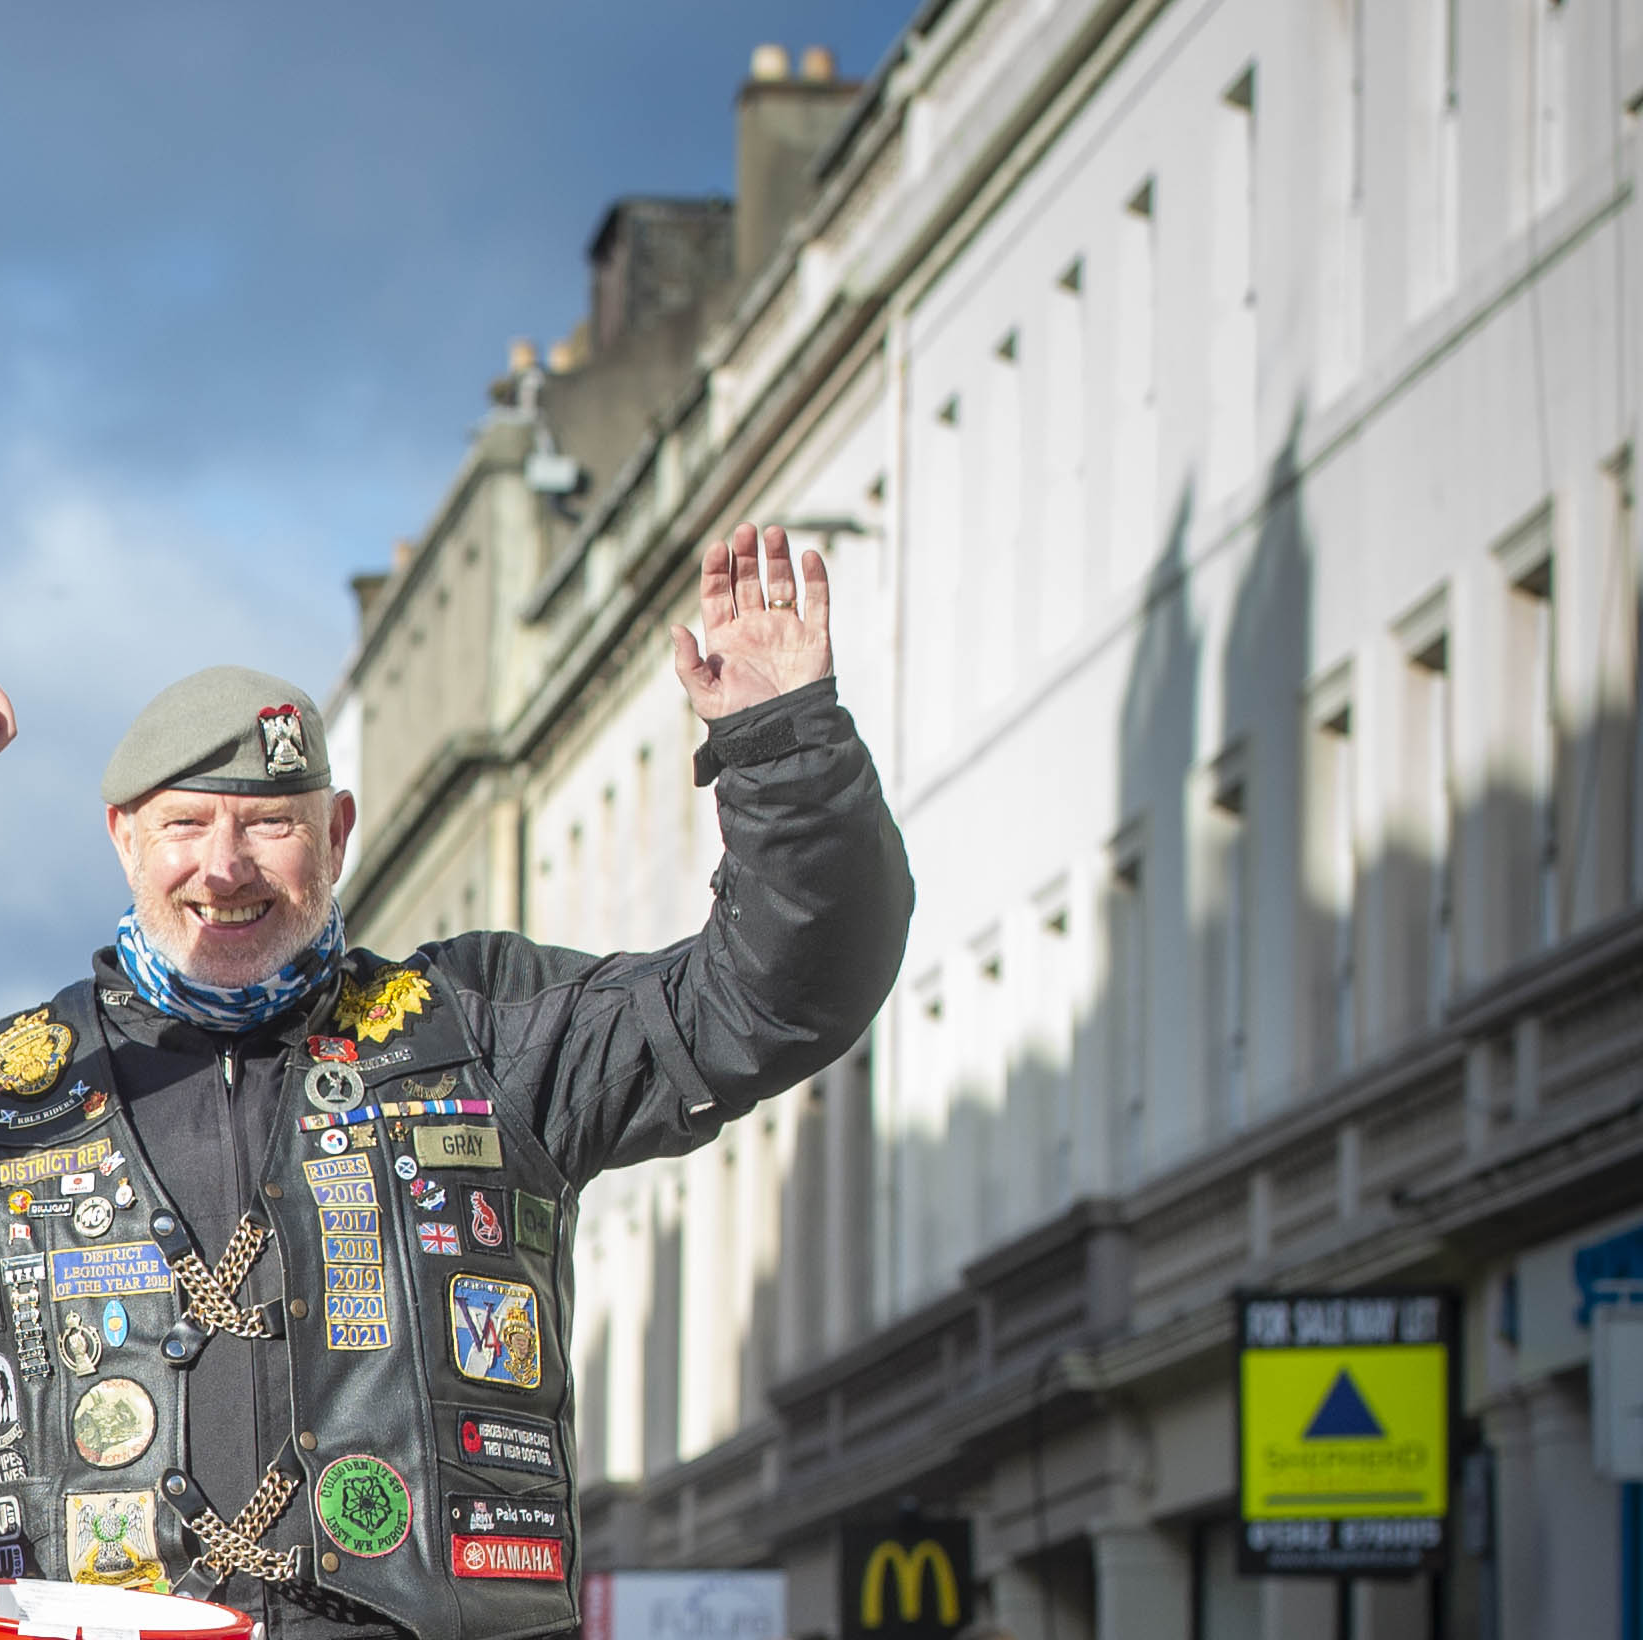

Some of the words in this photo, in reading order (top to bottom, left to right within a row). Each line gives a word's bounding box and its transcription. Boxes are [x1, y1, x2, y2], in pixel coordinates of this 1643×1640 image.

[17, 1114, 42, 1126] RBLS
[42, 1098, 76, 1119] RIDERS
[442, 1135, 484, 1157] GRAY
[0, 1153, 73, 1183] DISTRICT
[77, 1145, 107, 1168] REP
[308, 1158, 368, 1179] RIDERS
[321, 1183, 369, 1204] 2016
[329, 1211, 372, 1231] 2017
[82, 1247, 143, 1263] DISTRICT
[333, 1240, 374, 1260] 2018
[63, 1260, 160, 1280] LEGIONNAIRE
[333, 1269, 376, 1289] 2019
[55, 1284, 71, 1295] OF
[75, 1279, 103, 1293] THE
[104, 1275, 142, 1291] YEAR
[144, 1275, 170, 1288] 2018
[330, 1298, 380, 1318] 2020
[336, 1326, 381, 1346] 2021
[483, 1440, 502, 1457] THEY
[320, 1460, 369, 1498] CULLODEN
[375, 1463, 405, 1494] 1746
[496, 1507, 518, 1522] Paid
[519, 1508, 533, 1523] To
[534, 1509, 555, 1526] Play
[326, 1516, 353, 1543] LEST
[353, 1540, 373, 1551] WE
[378, 1509, 408, 1549] FORGET
[485, 1543, 555, 1572] YAMAHA
